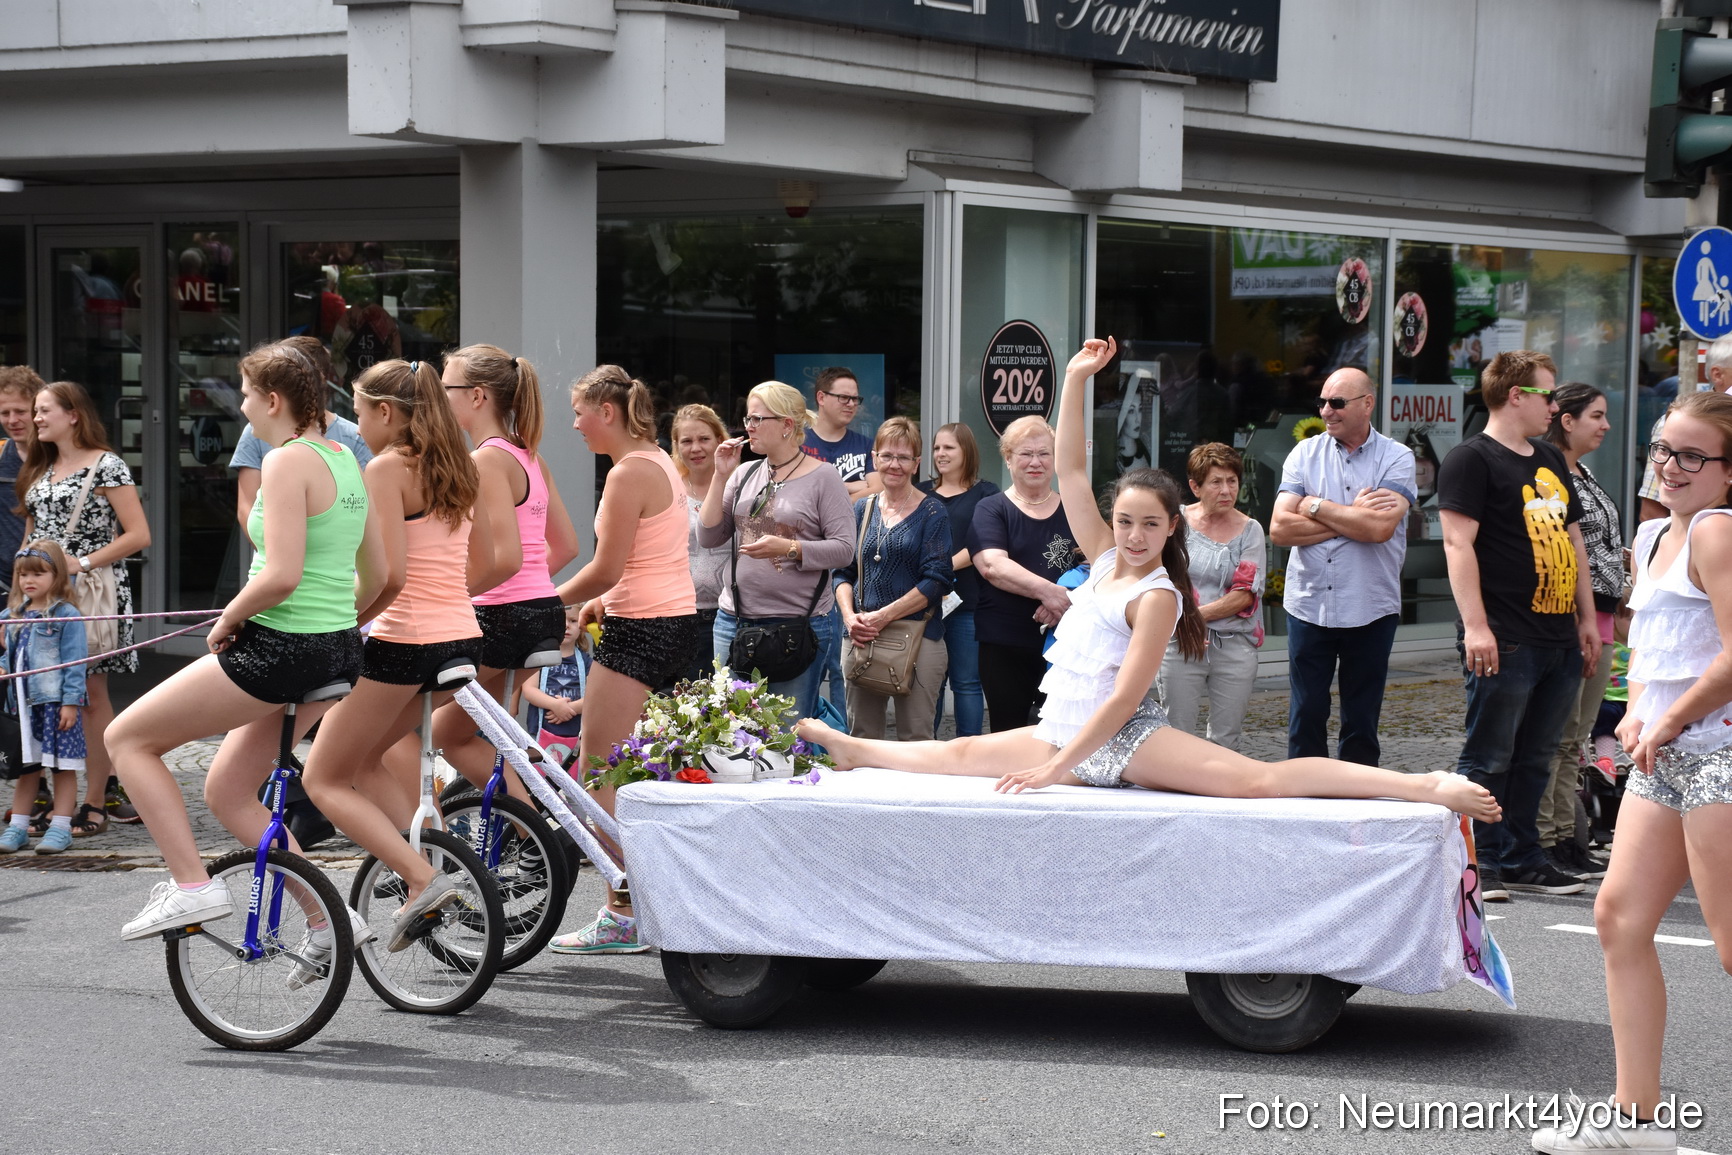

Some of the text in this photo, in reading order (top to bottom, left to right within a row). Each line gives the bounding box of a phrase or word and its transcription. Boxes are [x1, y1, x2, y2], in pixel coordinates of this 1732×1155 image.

[1350, 279, 1359, 289] 45
[1349, 292, 1359, 303] CB
[1406, 314, 1415, 323] 45
[1405, 327, 1415, 336] CB
[358, 334, 374, 349] 45
[995, 345, 1014, 353] JETZT
[1026, 345, 1042, 354] CLUB
[989, 356, 1048, 365] MITGLIED WERDEN!
[992, 368, 1045, 404] 20%
[200, 436, 222, 452] BPN
[272, 781, 282, 813] FISHBONE
[475, 818, 488, 857] SPORT
[248, 876, 261, 915] SPORT
